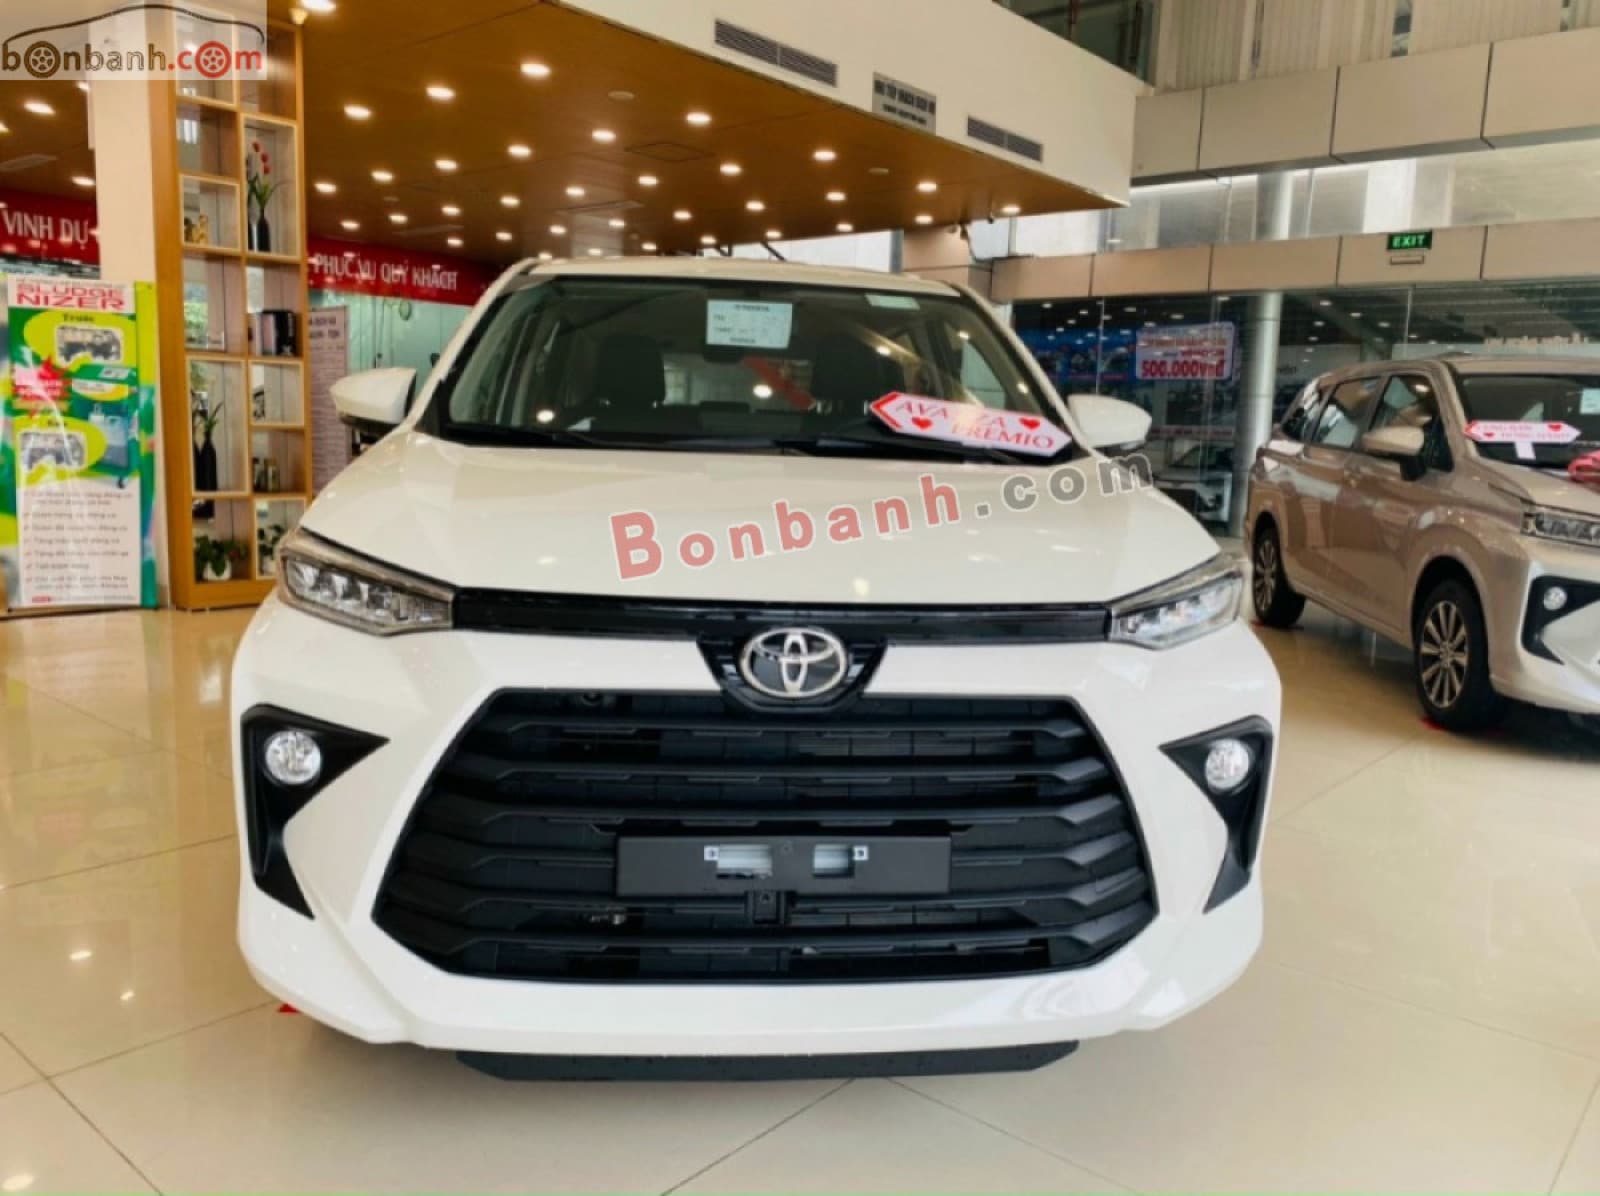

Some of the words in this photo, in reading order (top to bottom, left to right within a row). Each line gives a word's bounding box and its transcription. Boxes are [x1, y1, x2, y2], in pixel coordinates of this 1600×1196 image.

[1, 209, 53, 241] VINH
[1392, 235, 1425, 248] EXIT
[17, 293, 125, 310] NIZER
[896, 400, 1006, 429] AVAZA
